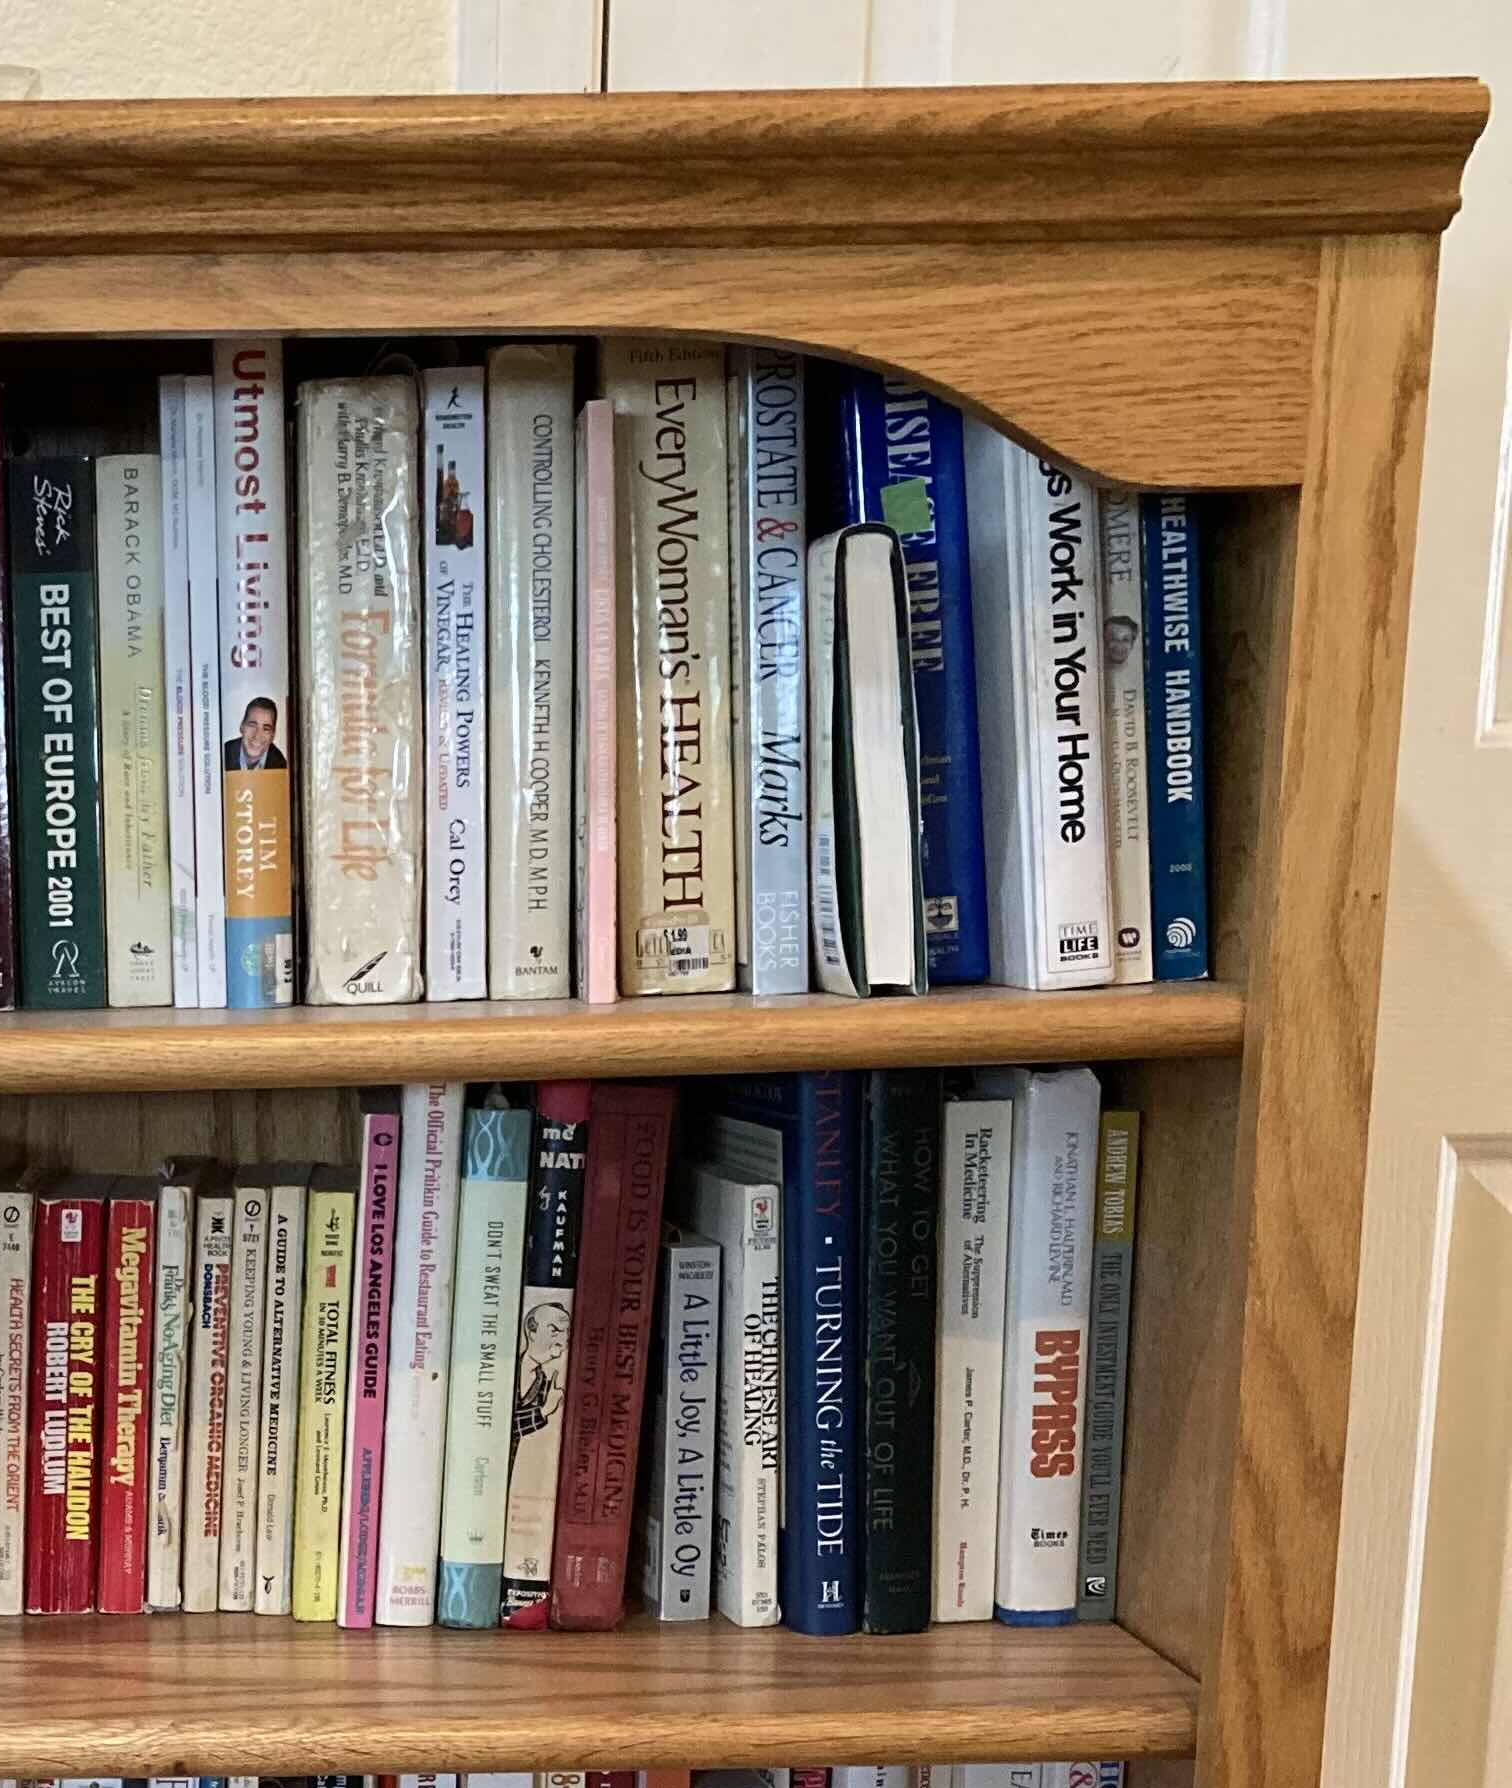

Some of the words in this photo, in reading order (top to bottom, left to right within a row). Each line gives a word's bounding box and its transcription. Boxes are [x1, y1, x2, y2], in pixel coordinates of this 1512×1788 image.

[123, 469, 139, 564] BARACK
[1048, 502, 1082, 603] Work
[39, 584, 71, 668] BEST
[126, 576, 142, 659] OBAMA
[1051, 611, 1083, 643] in
[41, 678, 72, 722] OF
[1052, 648, 1084, 726] Your
[1164, 669, 1193, 803] HANDBOOK
[44, 740, 76, 869] EUROPE
[759, 731, 802, 848] Marks
[1055, 733, 1086, 843] Home
[258, 818, 277, 872] TIM
[448, 818, 465, 852] Cal
[47, 877, 74, 928] 2001
[448, 858, 467, 905] Orey
[780, 891, 798, 969] FISHER
[347, 981, 384, 994] QUILL
[515, 966, 558, 976] BANTAM
[683, 1294, 710, 1310] A
[681, 1324, 709, 1382] Little
[815, 1255, 843, 1431] TURNING
[1026, 1329, 1080, 1478] BYPASS
[677, 1448, 705, 1464] A
[819, 1440, 836, 1470] the
[674, 1475, 704, 1535] Little
[816, 1474, 844, 1557] TIDE
[673, 1544, 702, 1579] Oy
